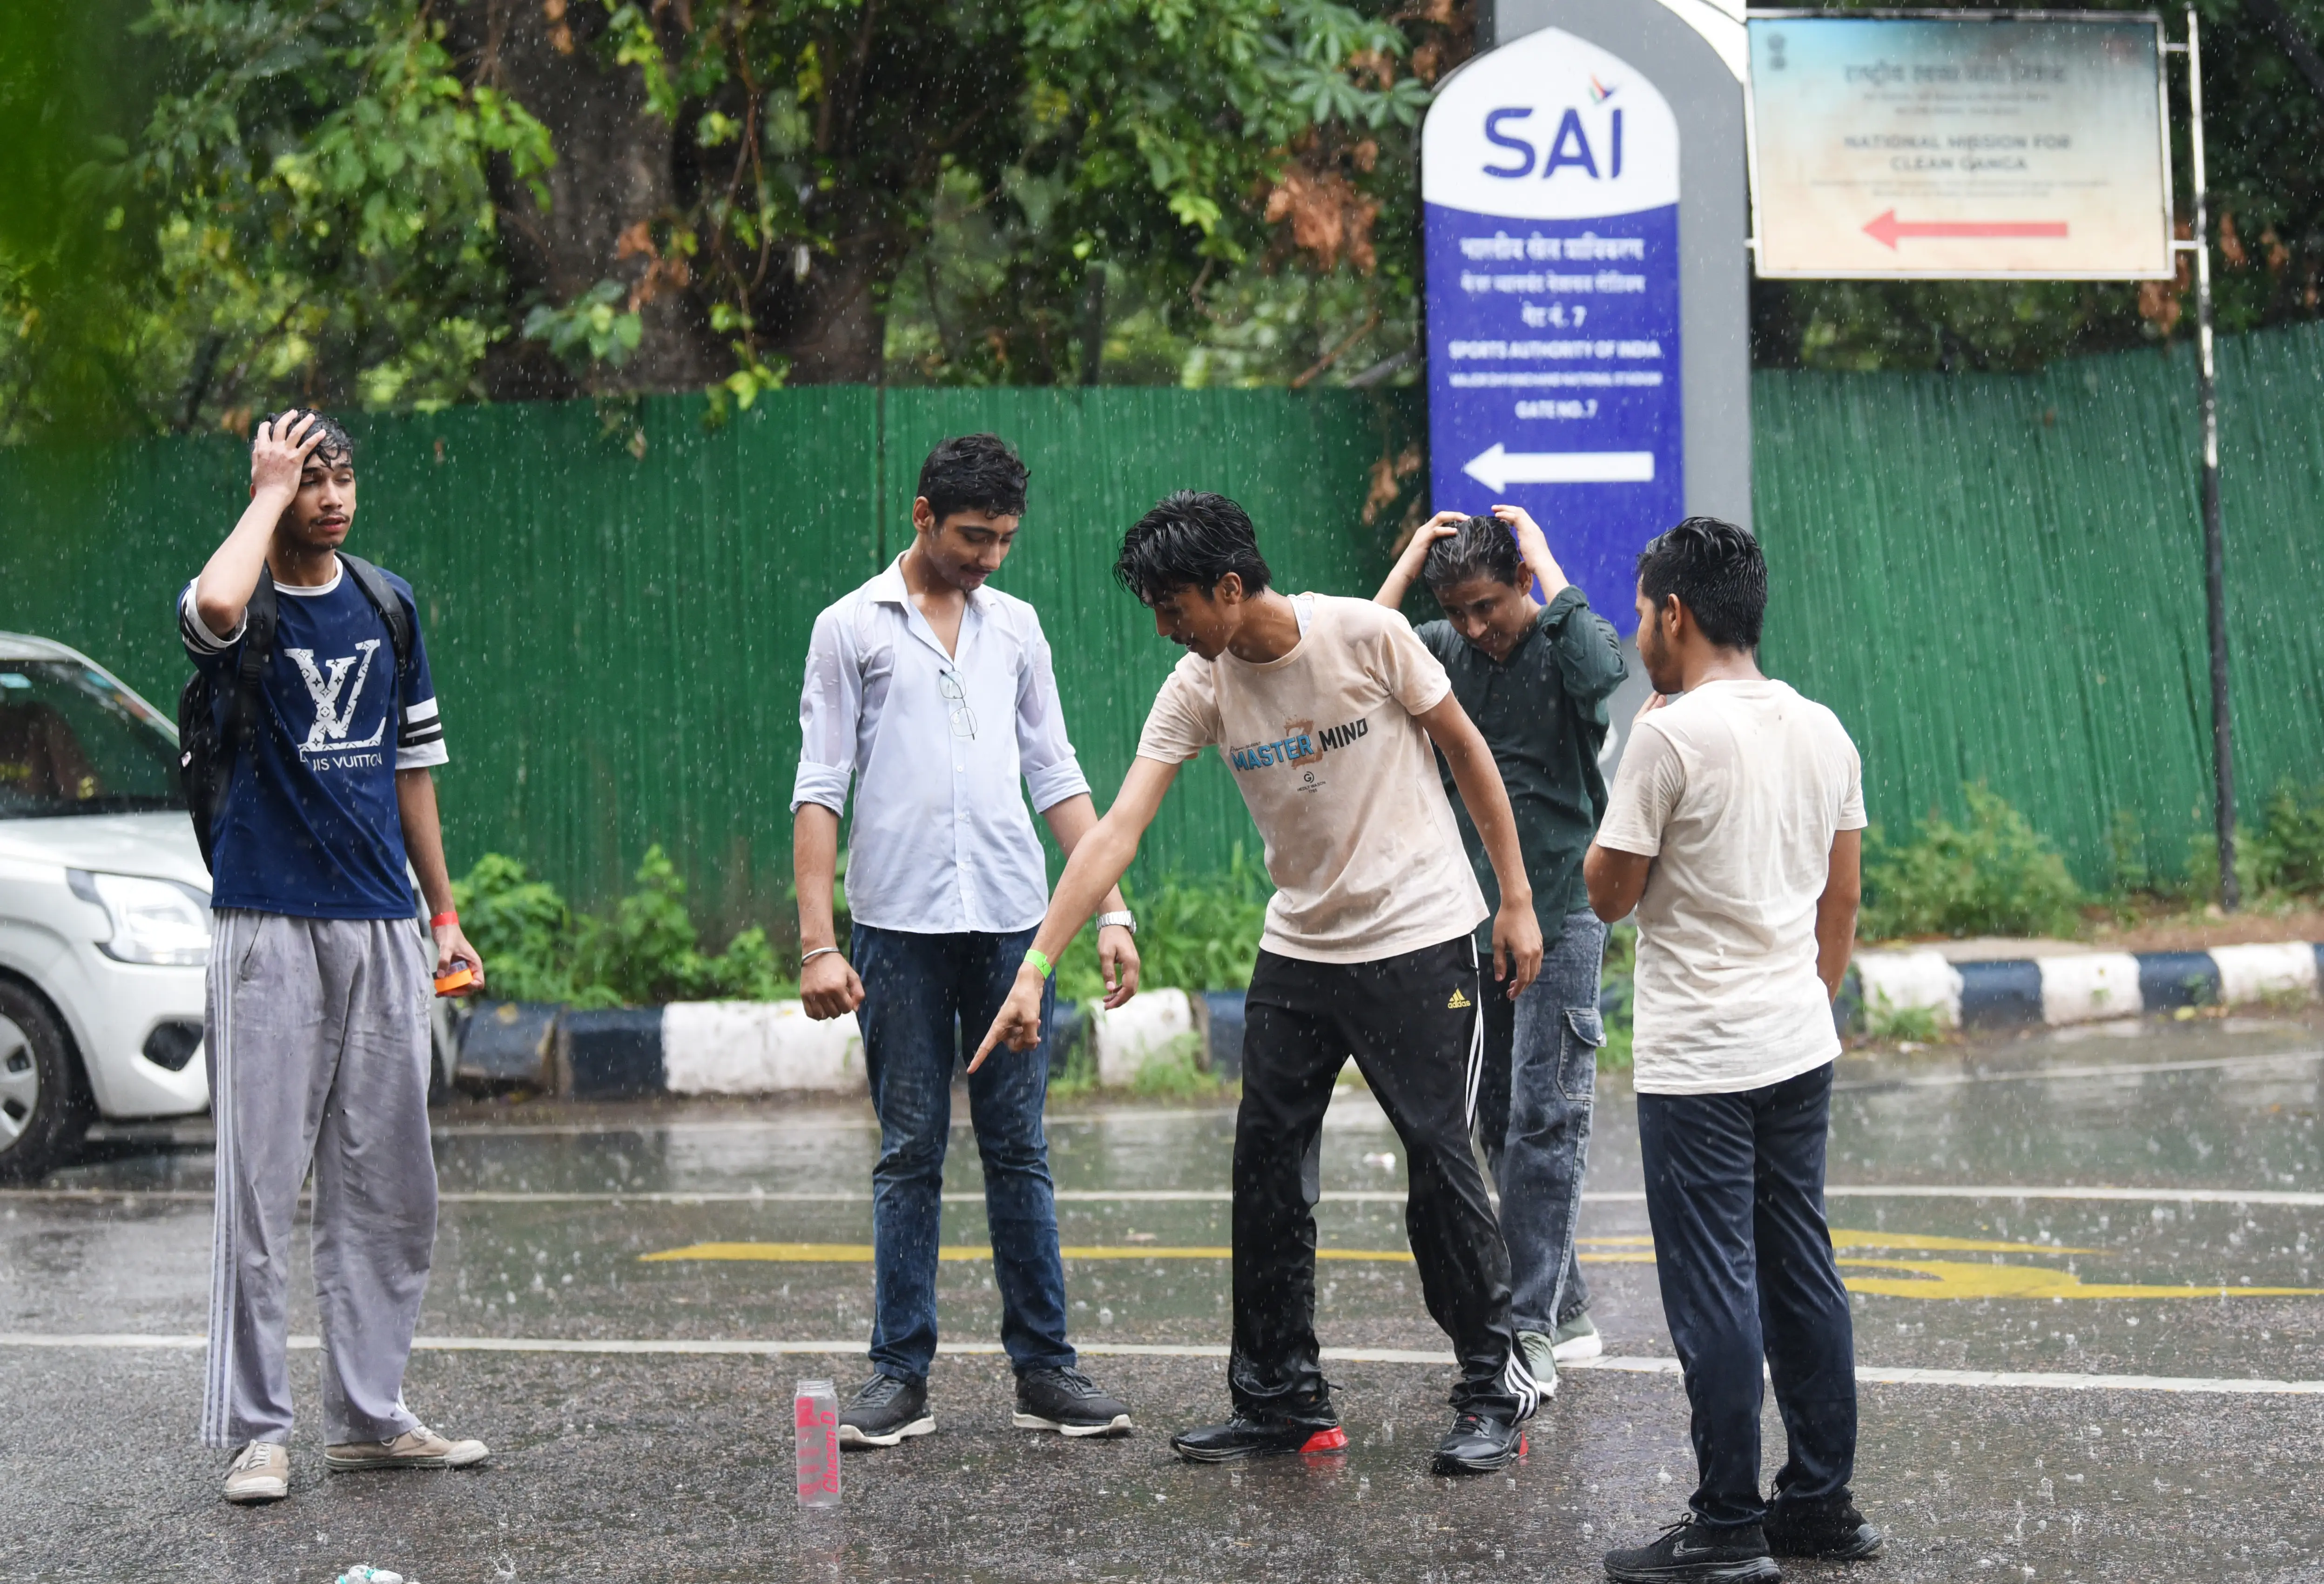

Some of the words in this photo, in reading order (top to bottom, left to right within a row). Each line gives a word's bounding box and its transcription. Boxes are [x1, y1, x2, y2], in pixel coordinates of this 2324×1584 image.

[1482, 107, 1622, 180] SAI
[1230, 735, 1314, 771] MASTER
[1318, 718, 1368, 752] MIND
[1448, 1000, 1471, 1009] adidas
[820, 1410, 838, 1494] Glucon-D
